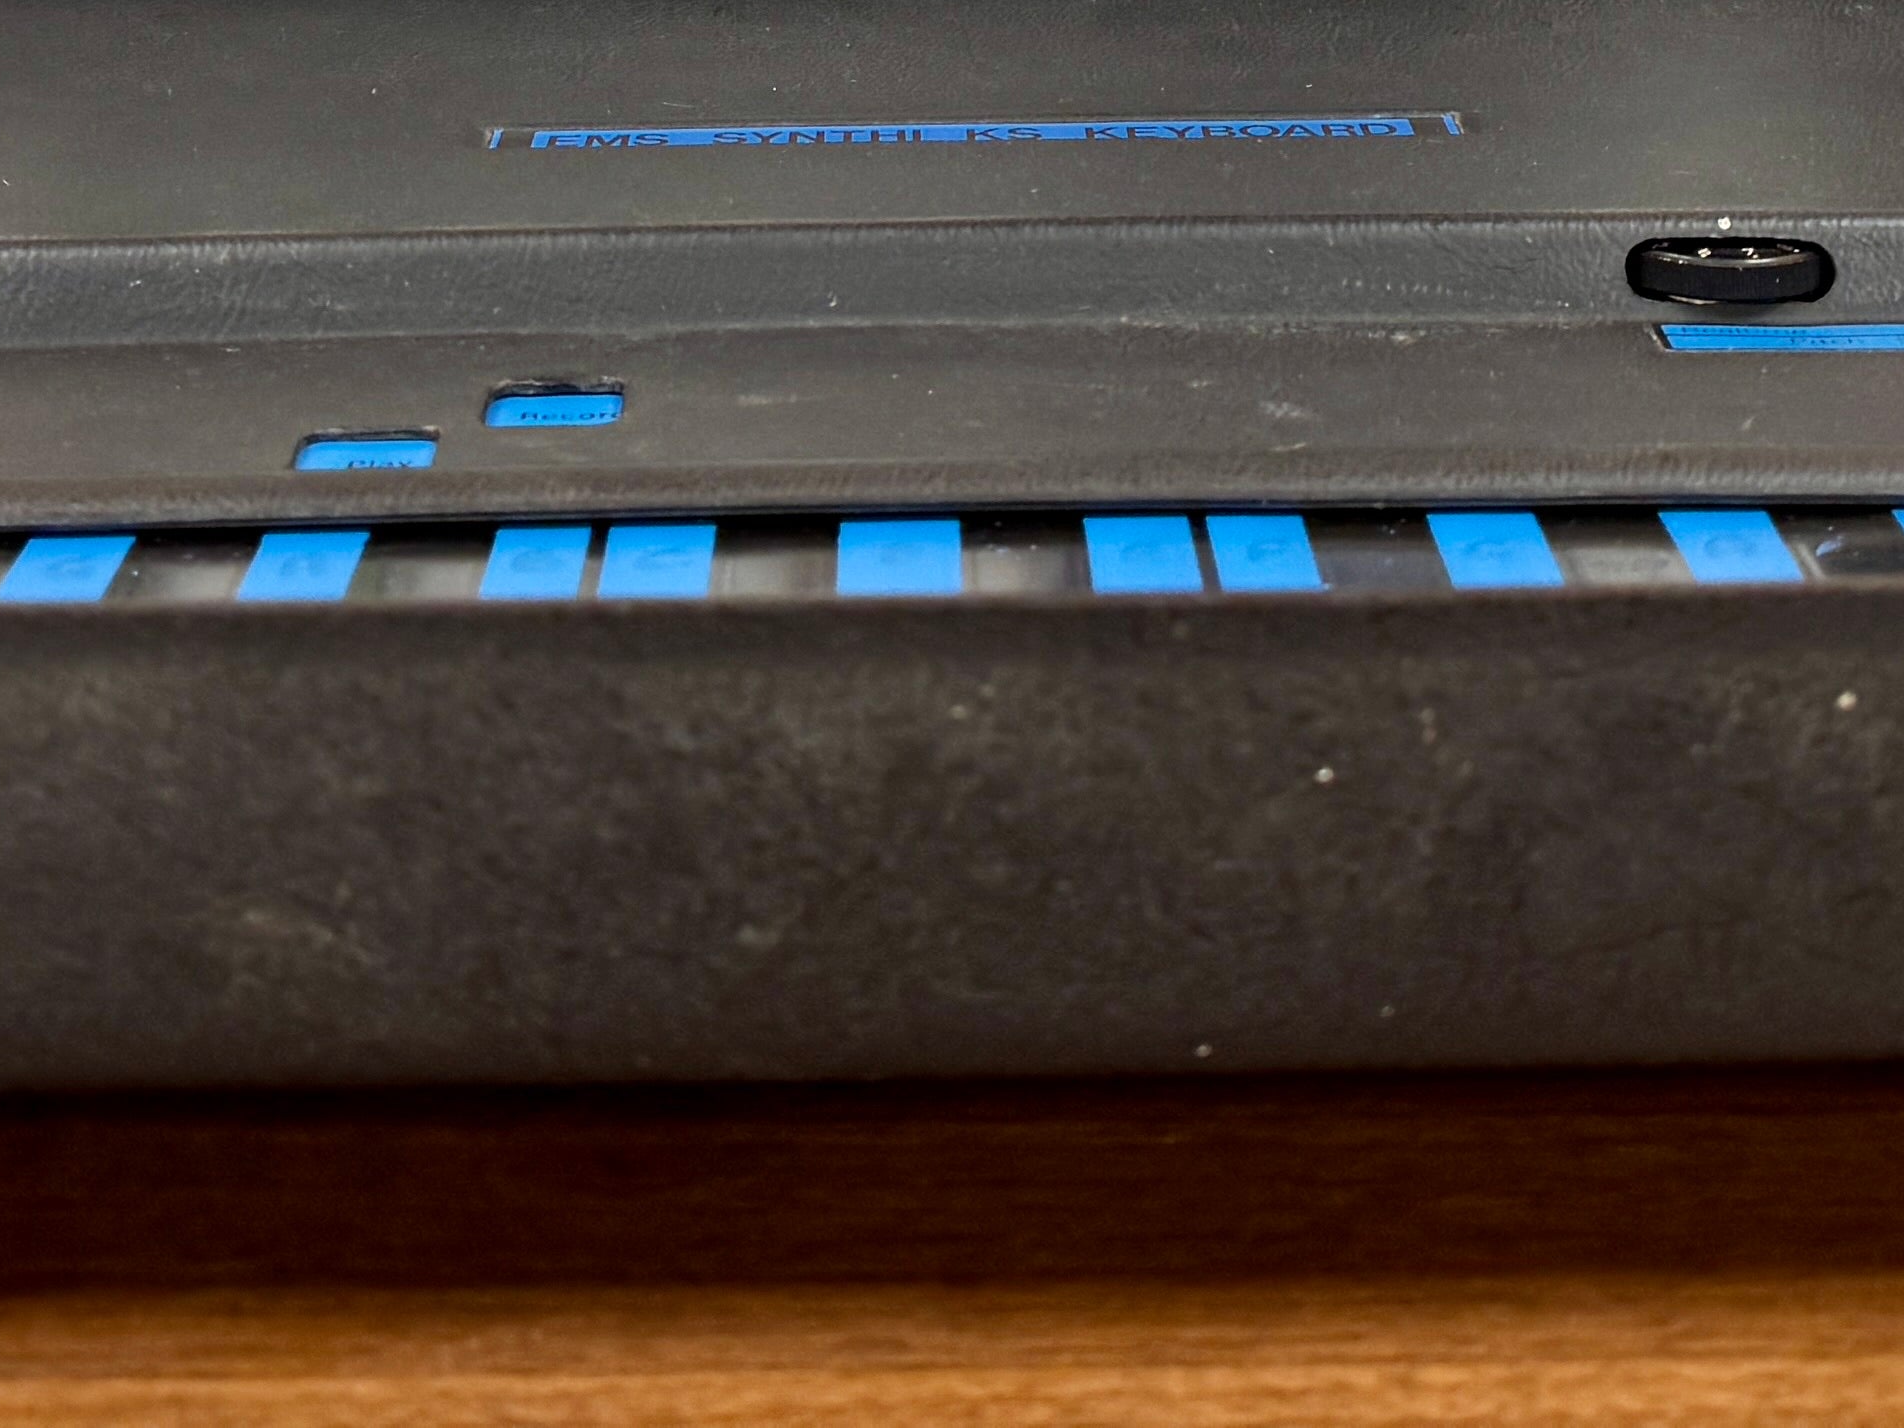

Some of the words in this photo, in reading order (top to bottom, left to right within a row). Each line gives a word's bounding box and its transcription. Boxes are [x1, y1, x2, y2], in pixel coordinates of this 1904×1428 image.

[545, 134, 669, 148] EMS
[713, 130, 922, 144] SYNTHI
[966, 127, 1041, 140] KS
[1086, 123, 1397, 139] KEYBOARD
